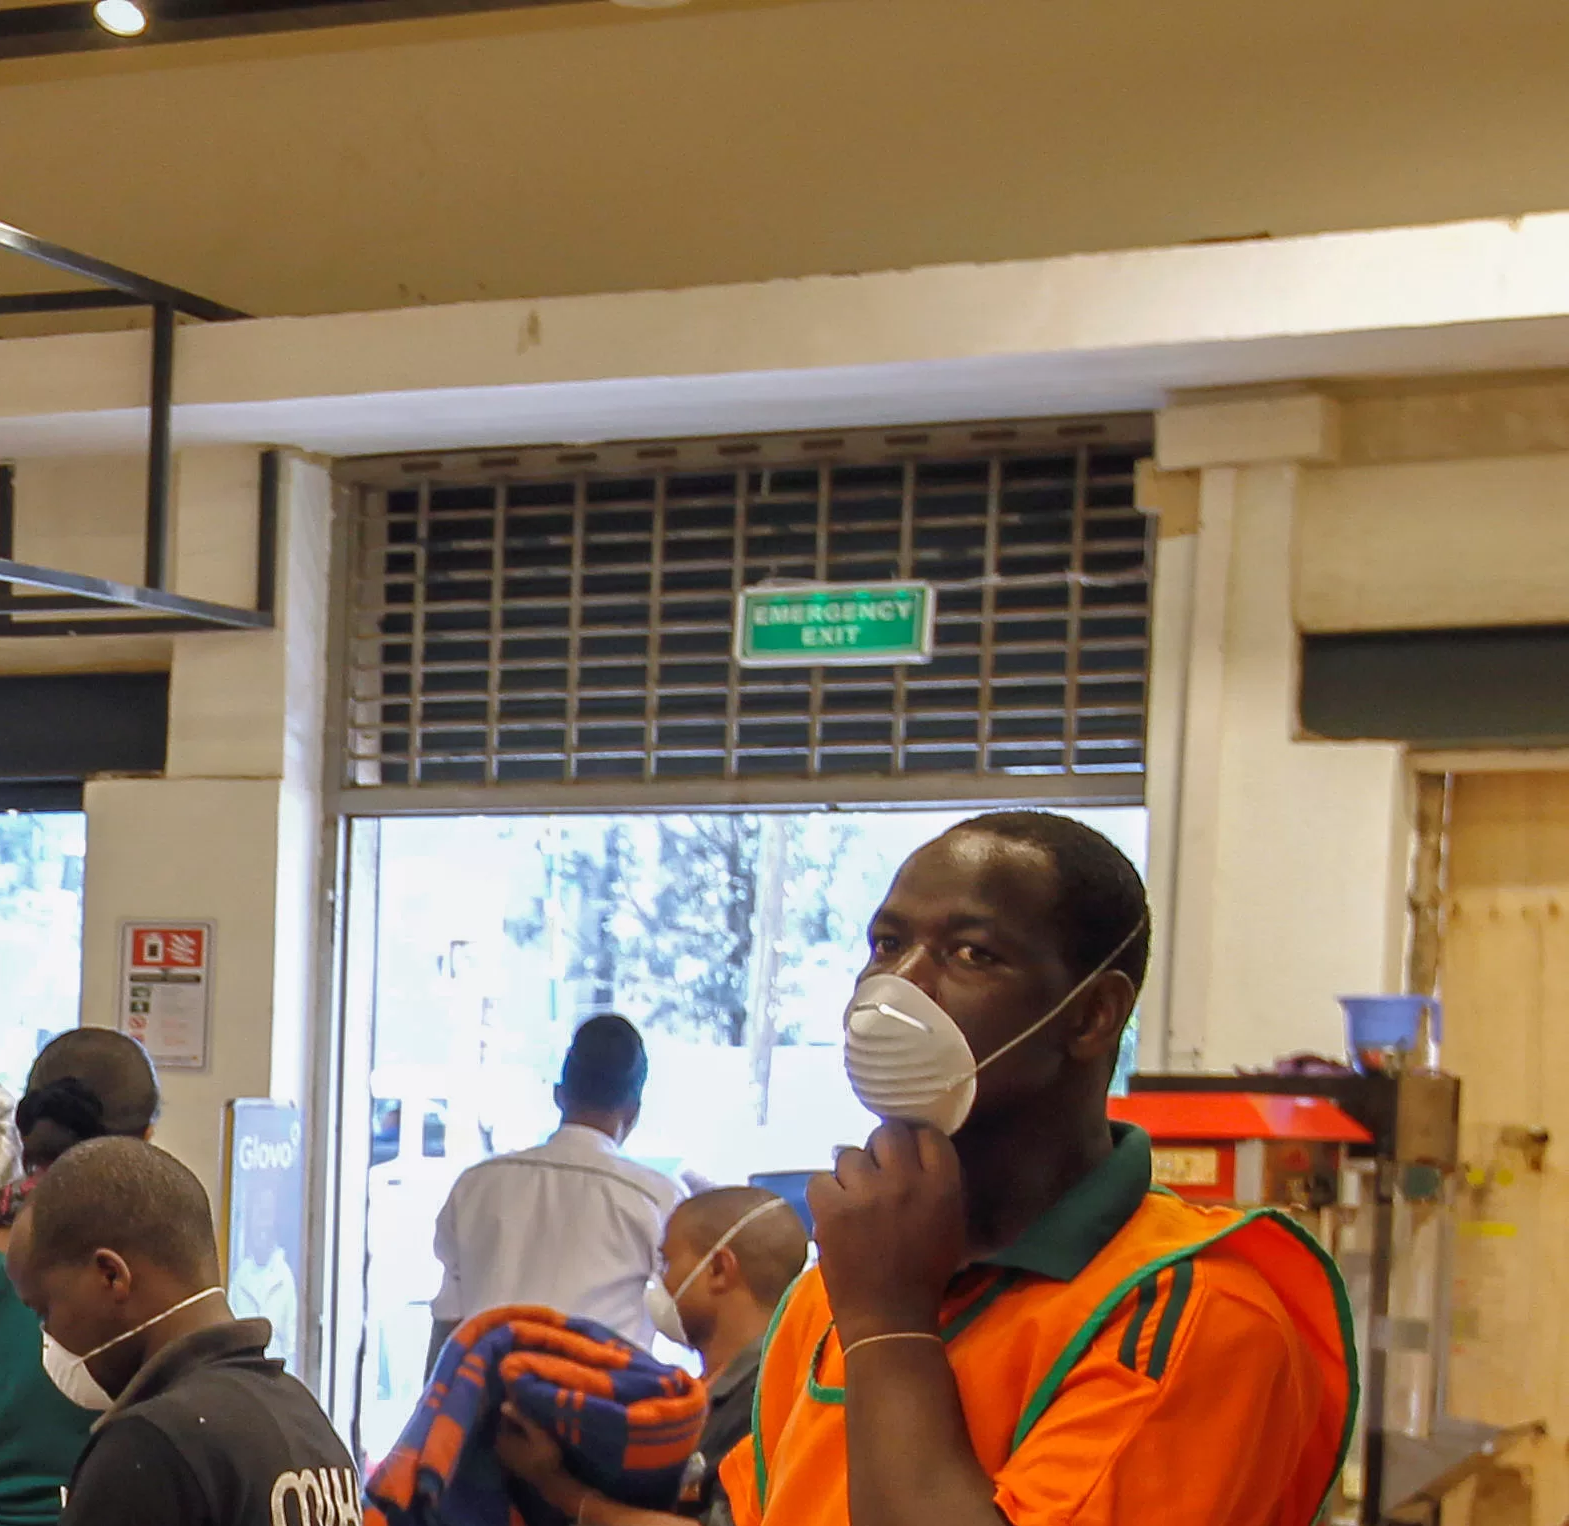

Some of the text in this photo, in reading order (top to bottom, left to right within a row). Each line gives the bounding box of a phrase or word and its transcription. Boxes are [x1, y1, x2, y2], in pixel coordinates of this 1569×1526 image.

[753, 601, 913, 626] EMERGENCY
[801, 624, 861, 646] EXIT
[239, 1136, 293, 1170] Glovo
